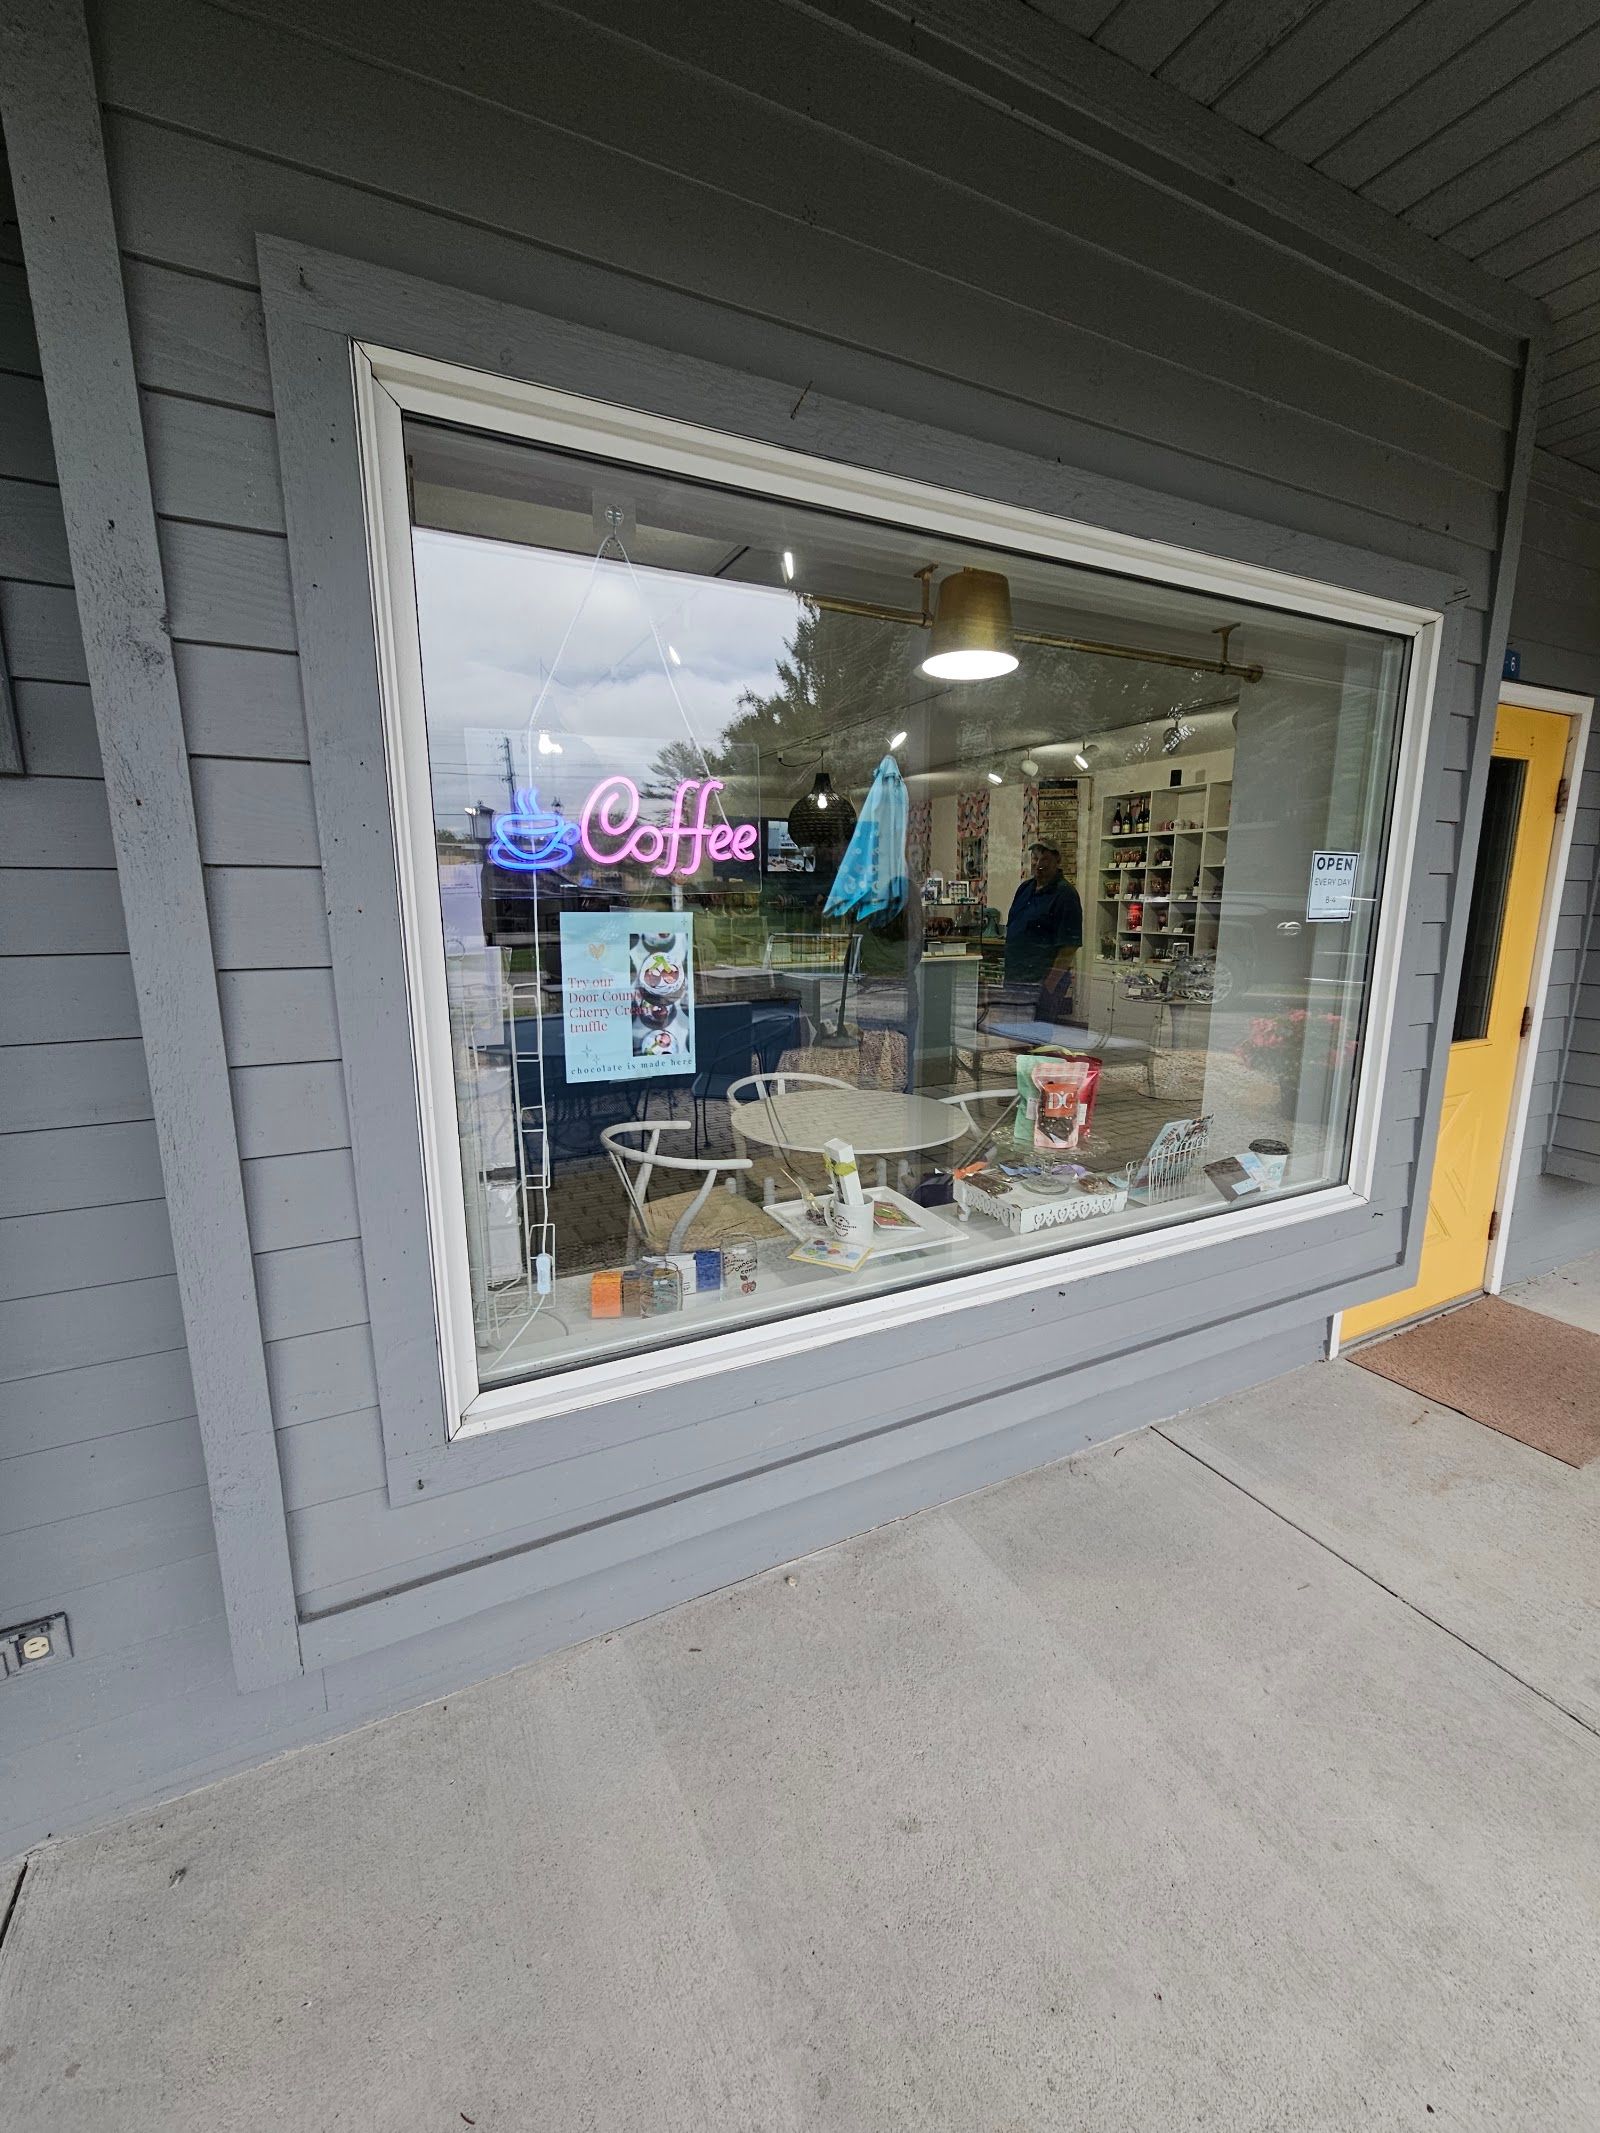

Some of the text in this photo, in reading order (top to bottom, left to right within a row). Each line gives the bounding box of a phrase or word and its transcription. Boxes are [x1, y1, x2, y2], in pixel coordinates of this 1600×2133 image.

[581, 776, 758, 876] Coffee
[1316, 857, 1354, 870] OPEN
[1314, 878, 1351, 886] EVERY DAY
[568, 977, 614, 990] Try our
[569, 992, 599, 1003] Door
[569, 1006, 611, 1018] Cherry
[570, 1021, 608, 1033] truffle
[571, 1064, 623, 1075] chocolate
[641, 1060, 666, 1069] made
[670, 1058, 692, 1066] here
